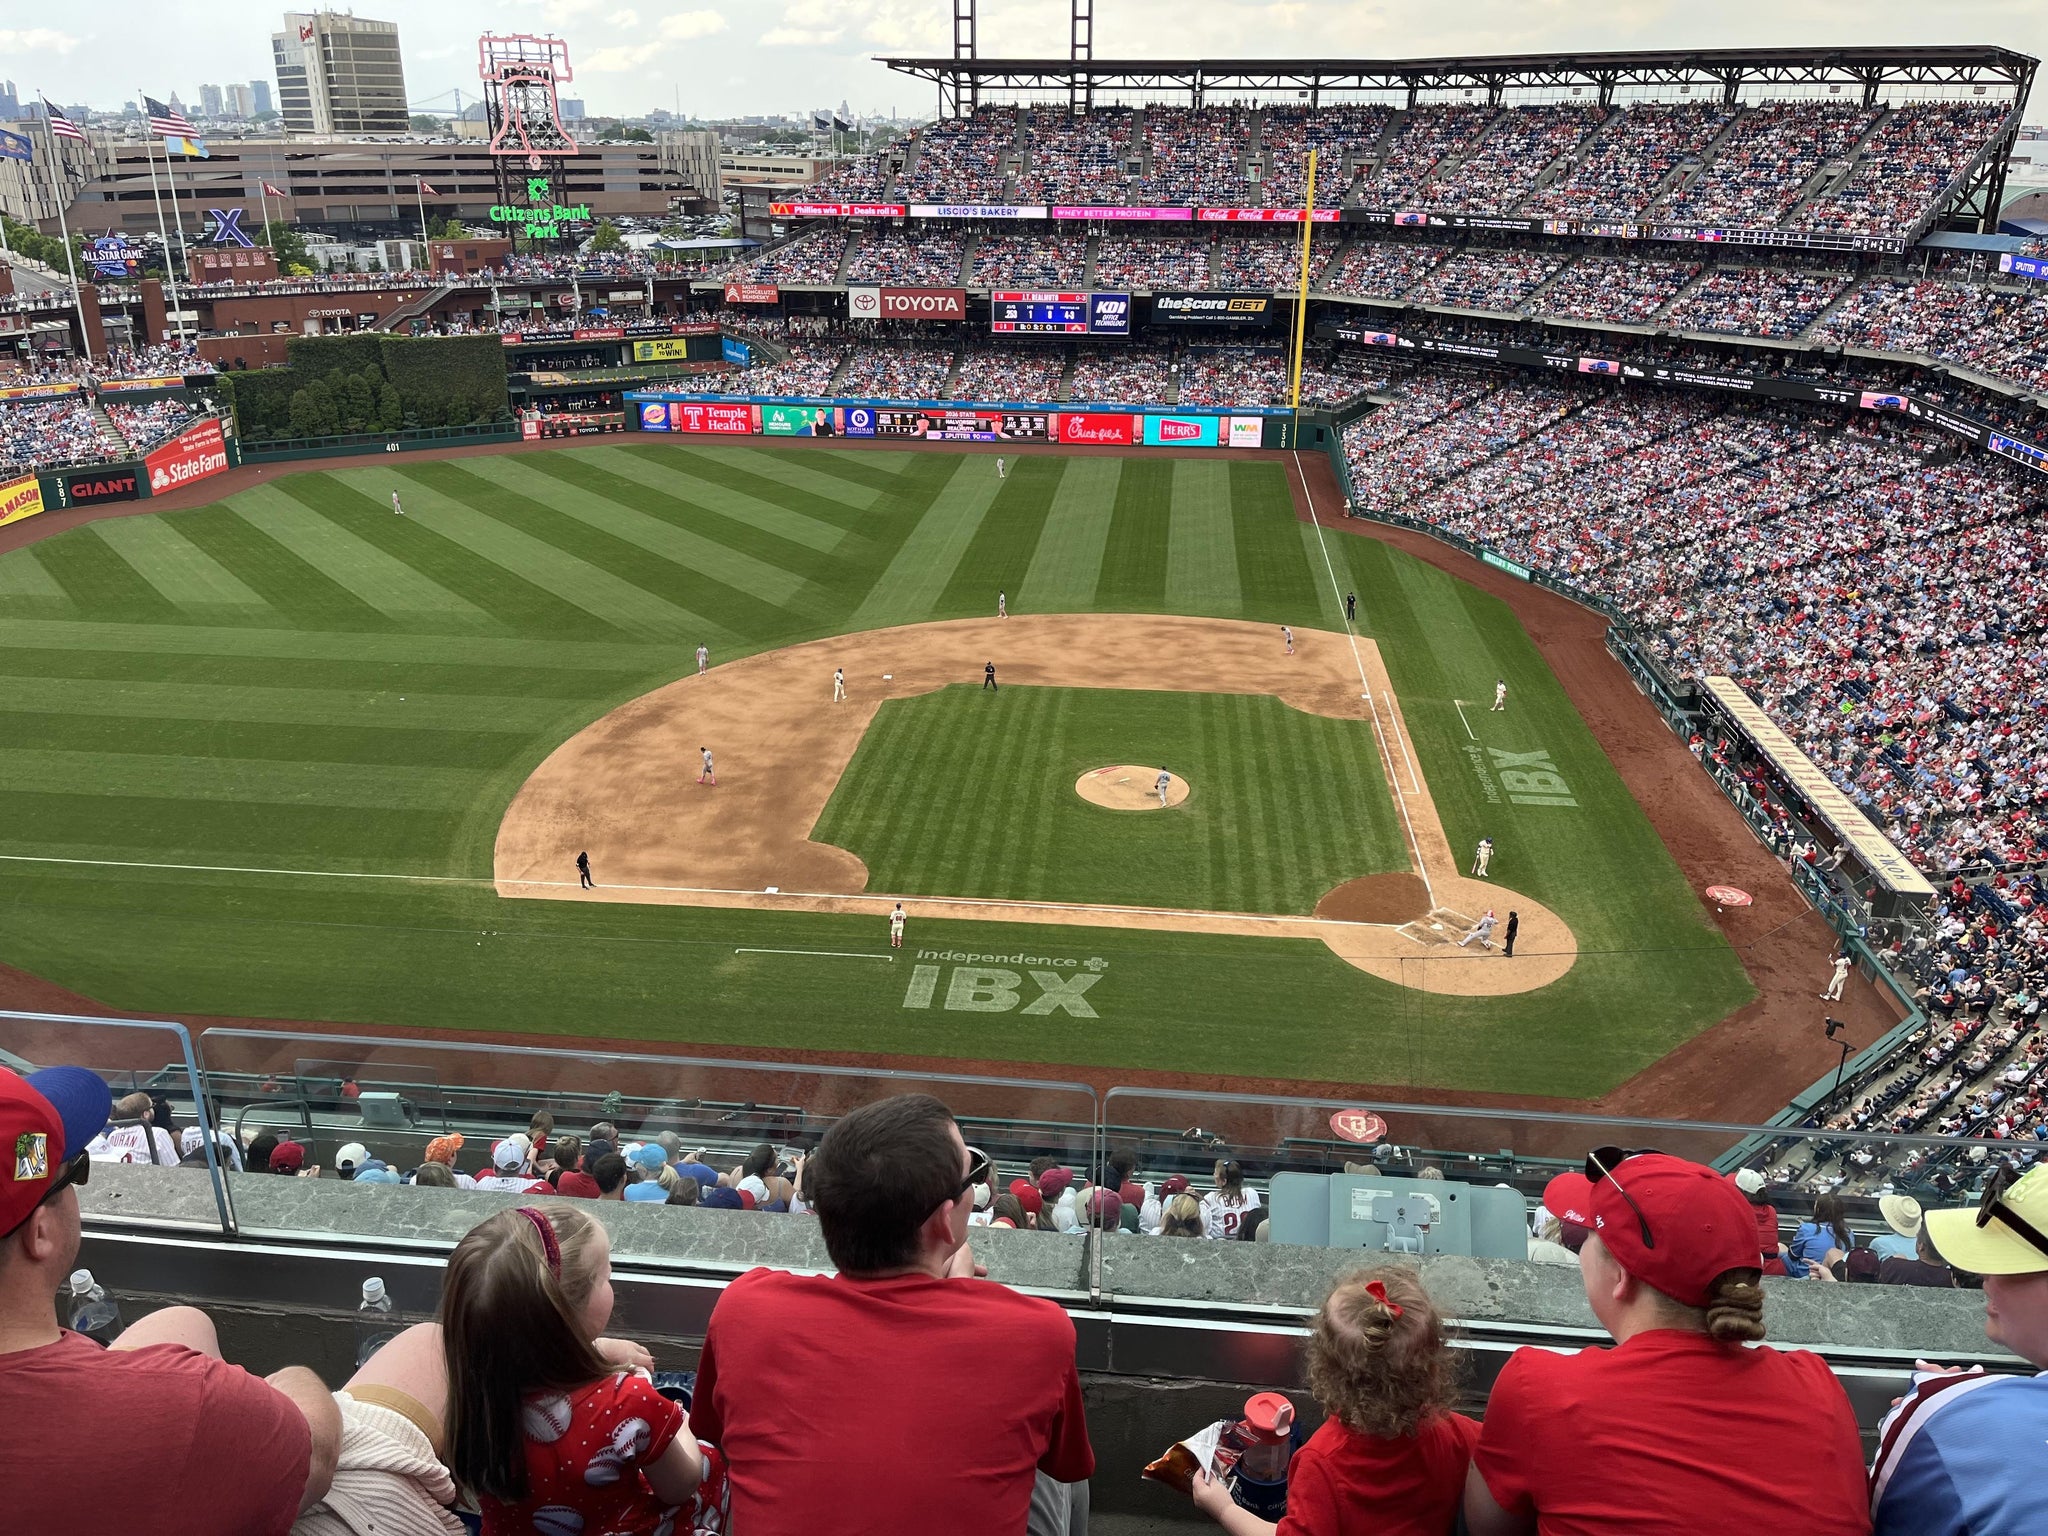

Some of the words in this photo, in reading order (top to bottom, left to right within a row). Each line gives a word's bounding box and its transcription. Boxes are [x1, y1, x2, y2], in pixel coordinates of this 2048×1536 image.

[490, 205, 550, 222] Citizens
[553, 204, 591, 220] Bank
[794, 205, 822, 215] Phillies
[823, 206, 837, 215] win
[854, 207, 875, 216] Deals
[876, 207, 890, 216] roll
[890, 207, 898, 216] in
[937, 207, 978, 216] LISCIO'S
[981, 208, 1018, 217] BAKERY
[1057, 209, 1082, 218] WHEY
[1083, 209, 1114, 218] BETTER
[1115, 209, 1151, 218] PROTEIN
[1202, 209, 1229, 220] Coca-Cola
[1237, 209, 1264, 220] Coca-Cola
[1272, 210, 1299, 221] Coca-Cola
[526, 222, 560, 239] Park
[82, 250, 99, 262] ALL
[98, 249, 121, 261] STAR
[120, 248, 145, 260] GAME
[2015, 261, 2036, 274] SPLITTER
[884, 295, 959, 312] TOYOTA
[1095, 301, 1127, 314] KDI
[1157, 297, 1228, 310] theScore
[1231, 300, 1263, 310] BET
[320, 308, 351, 316] TOYOTA
[1028, 310, 1033, 319] 1
[588, 329, 619, 338] Budweiser
[656, 342, 674, 350] PLAY
[1546, 359, 1568, 368] XT5
[119, 380, 151, 391] Surfside
[22, 388, 54, 398] Surfside
[706, 407, 748, 421] Temple
[856, 414, 864, 422] R
[707, 419, 747, 431] Health
[1067, 419, 1123, 440] Chick-fil-A
[1164, 424, 1197, 436] HERR'S
[1234, 424, 1258, 432] WM
[385, 443, 400, 452] 401
[56, 477, 67, 508] 387
[71, 478, 136, 497] GIANT
[1708, 681, 1777, 730] PHILLIES
[1469, 752, 1502, 804] Independence
[1486, 746, 1579, 807] IBX
[1763, 736, 1880, 838] PHILADELPHIA
[1872, 852, 1914, 881] HOME
[916, 948, 1077, 967] Independence
[902, 964, 1105, 1019] IBX
[1223, 1211, 1249, 1236] 2
